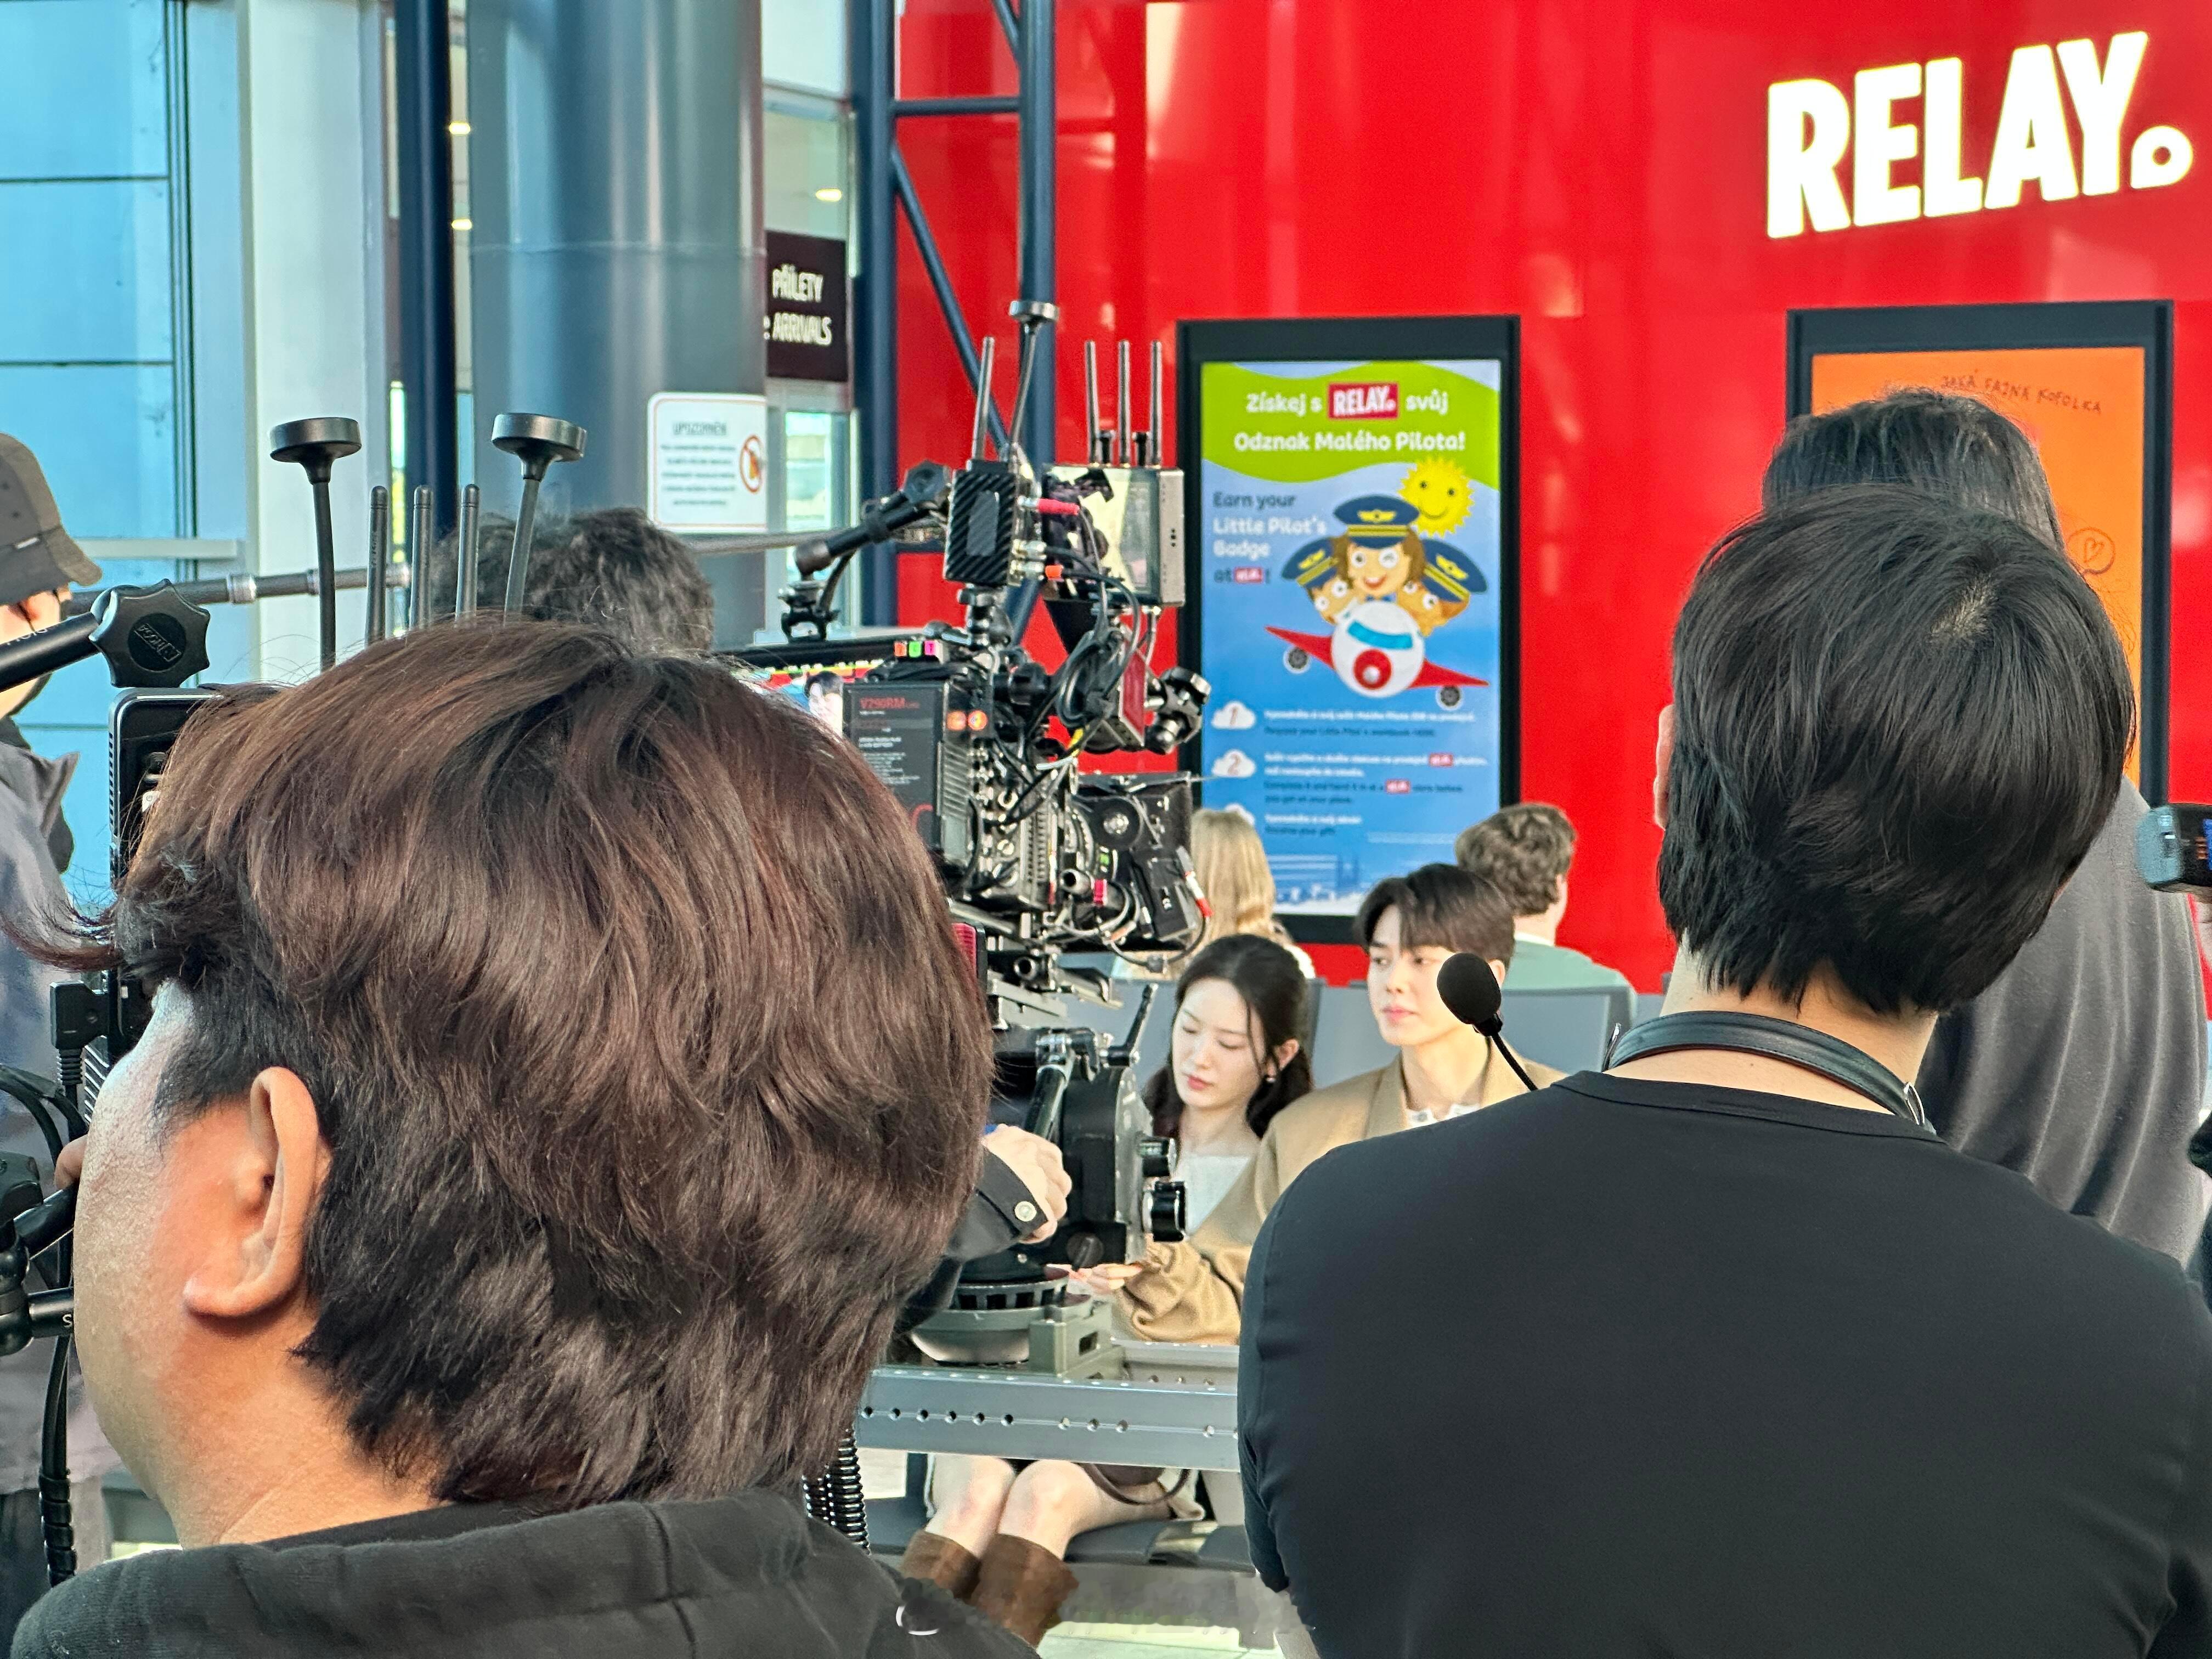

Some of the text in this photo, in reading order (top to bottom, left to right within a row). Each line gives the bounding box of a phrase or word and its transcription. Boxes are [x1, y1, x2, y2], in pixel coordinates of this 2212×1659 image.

[772, 312, 832, 346] ARRIVALS
[1246, 391, 1306, 417] Získej
[1311, 396, 1323, 413] s
[1406, 389, 1448, 415] svůj
[1234, 430, 1466, 452] Odznak Malého Pilota!
[1212, 492, 1296, 511] Earn your
[1213, 516, 1327, 535] Little Pilot's
[1228, 754, 1241, 775] 2
